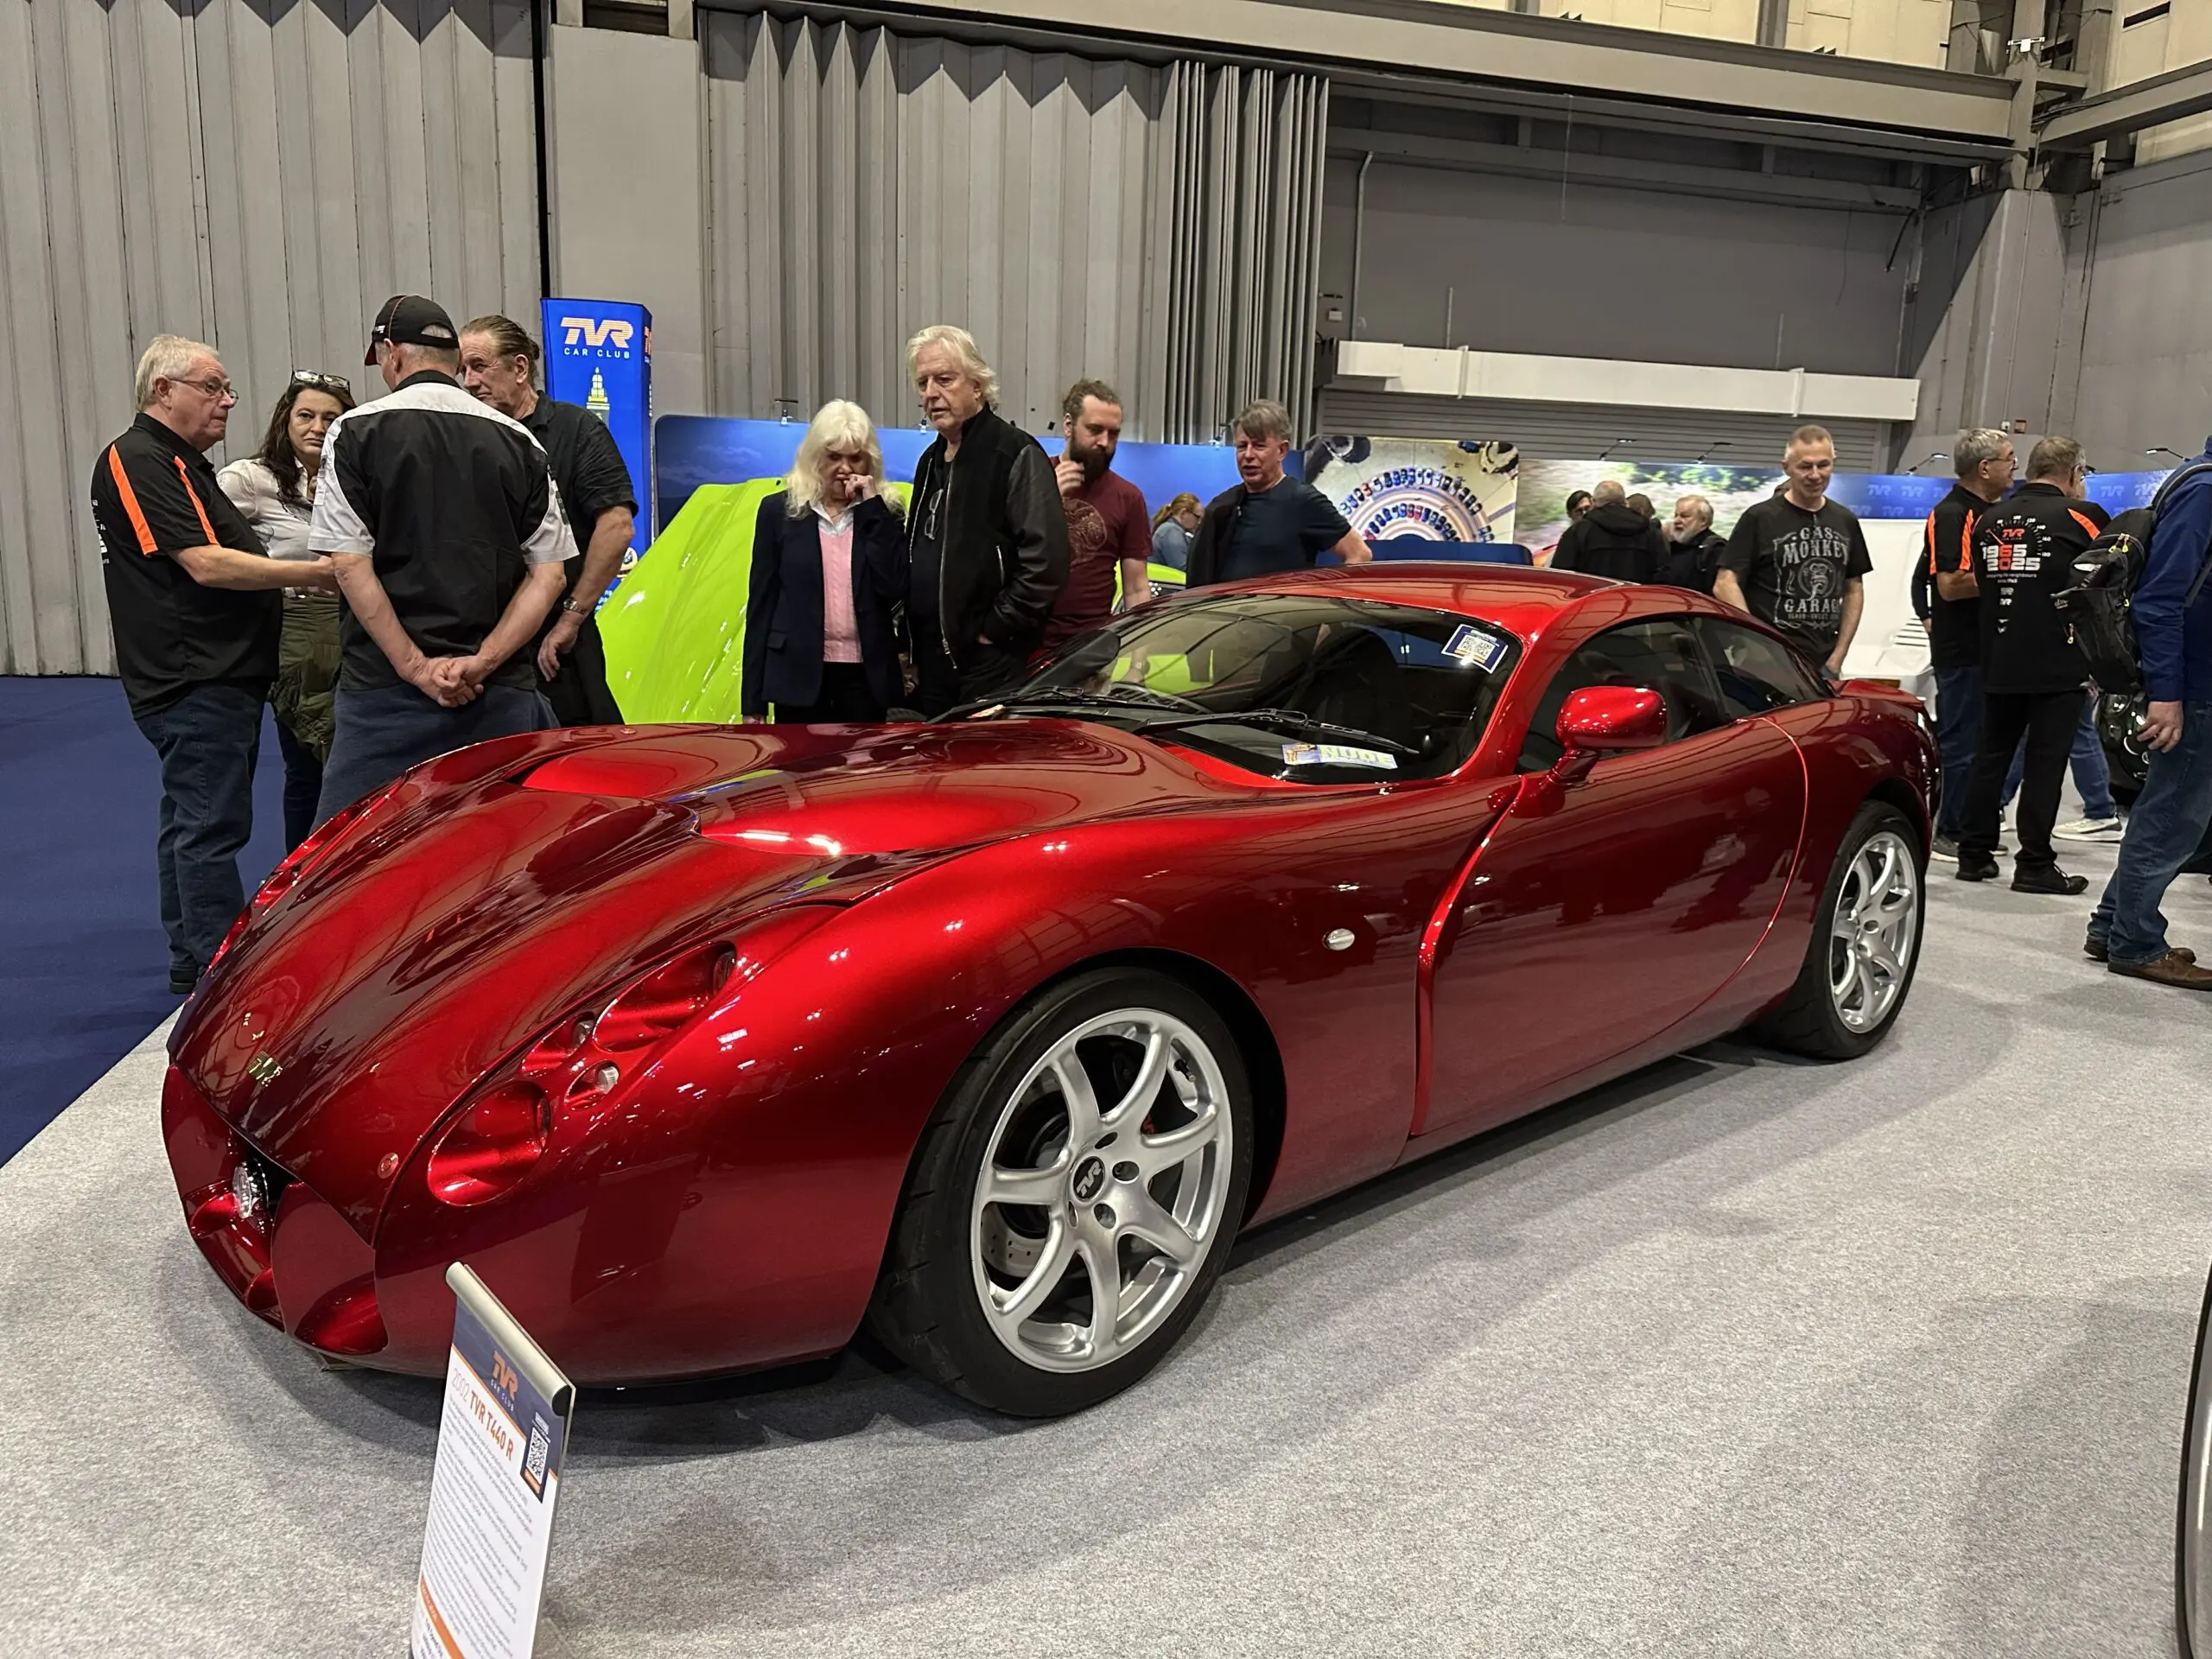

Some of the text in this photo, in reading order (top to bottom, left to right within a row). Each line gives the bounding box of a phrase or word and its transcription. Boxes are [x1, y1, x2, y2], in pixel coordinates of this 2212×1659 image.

[561, 317, 633, 348] TVR
[564, 347, 630, 359] CAR CLUB
[1867, 485, 1891, 496] TVR
[1902, 486, 1924, 497] TVR
[2101, 485, 2125, 498] TVR
[1882, 506, 1904, 517] TVR
[1799, 526, 1834, 540] GAS
[2002, 528, 2025, 537] TVR
[1782, 539, 1848, 568] MONKEY
[1981, 543, 2027, 560] 1965
[1986, 556, 2041, 571] 2025
[1076, 1160, 1102, 1197] TVR
[493, 1350, 518, 1402] TVR
[470, 1389, 486, 1425] TVR
[486, 1412, 506, 1450] T440
[505, 1438, 514, 1461] R
